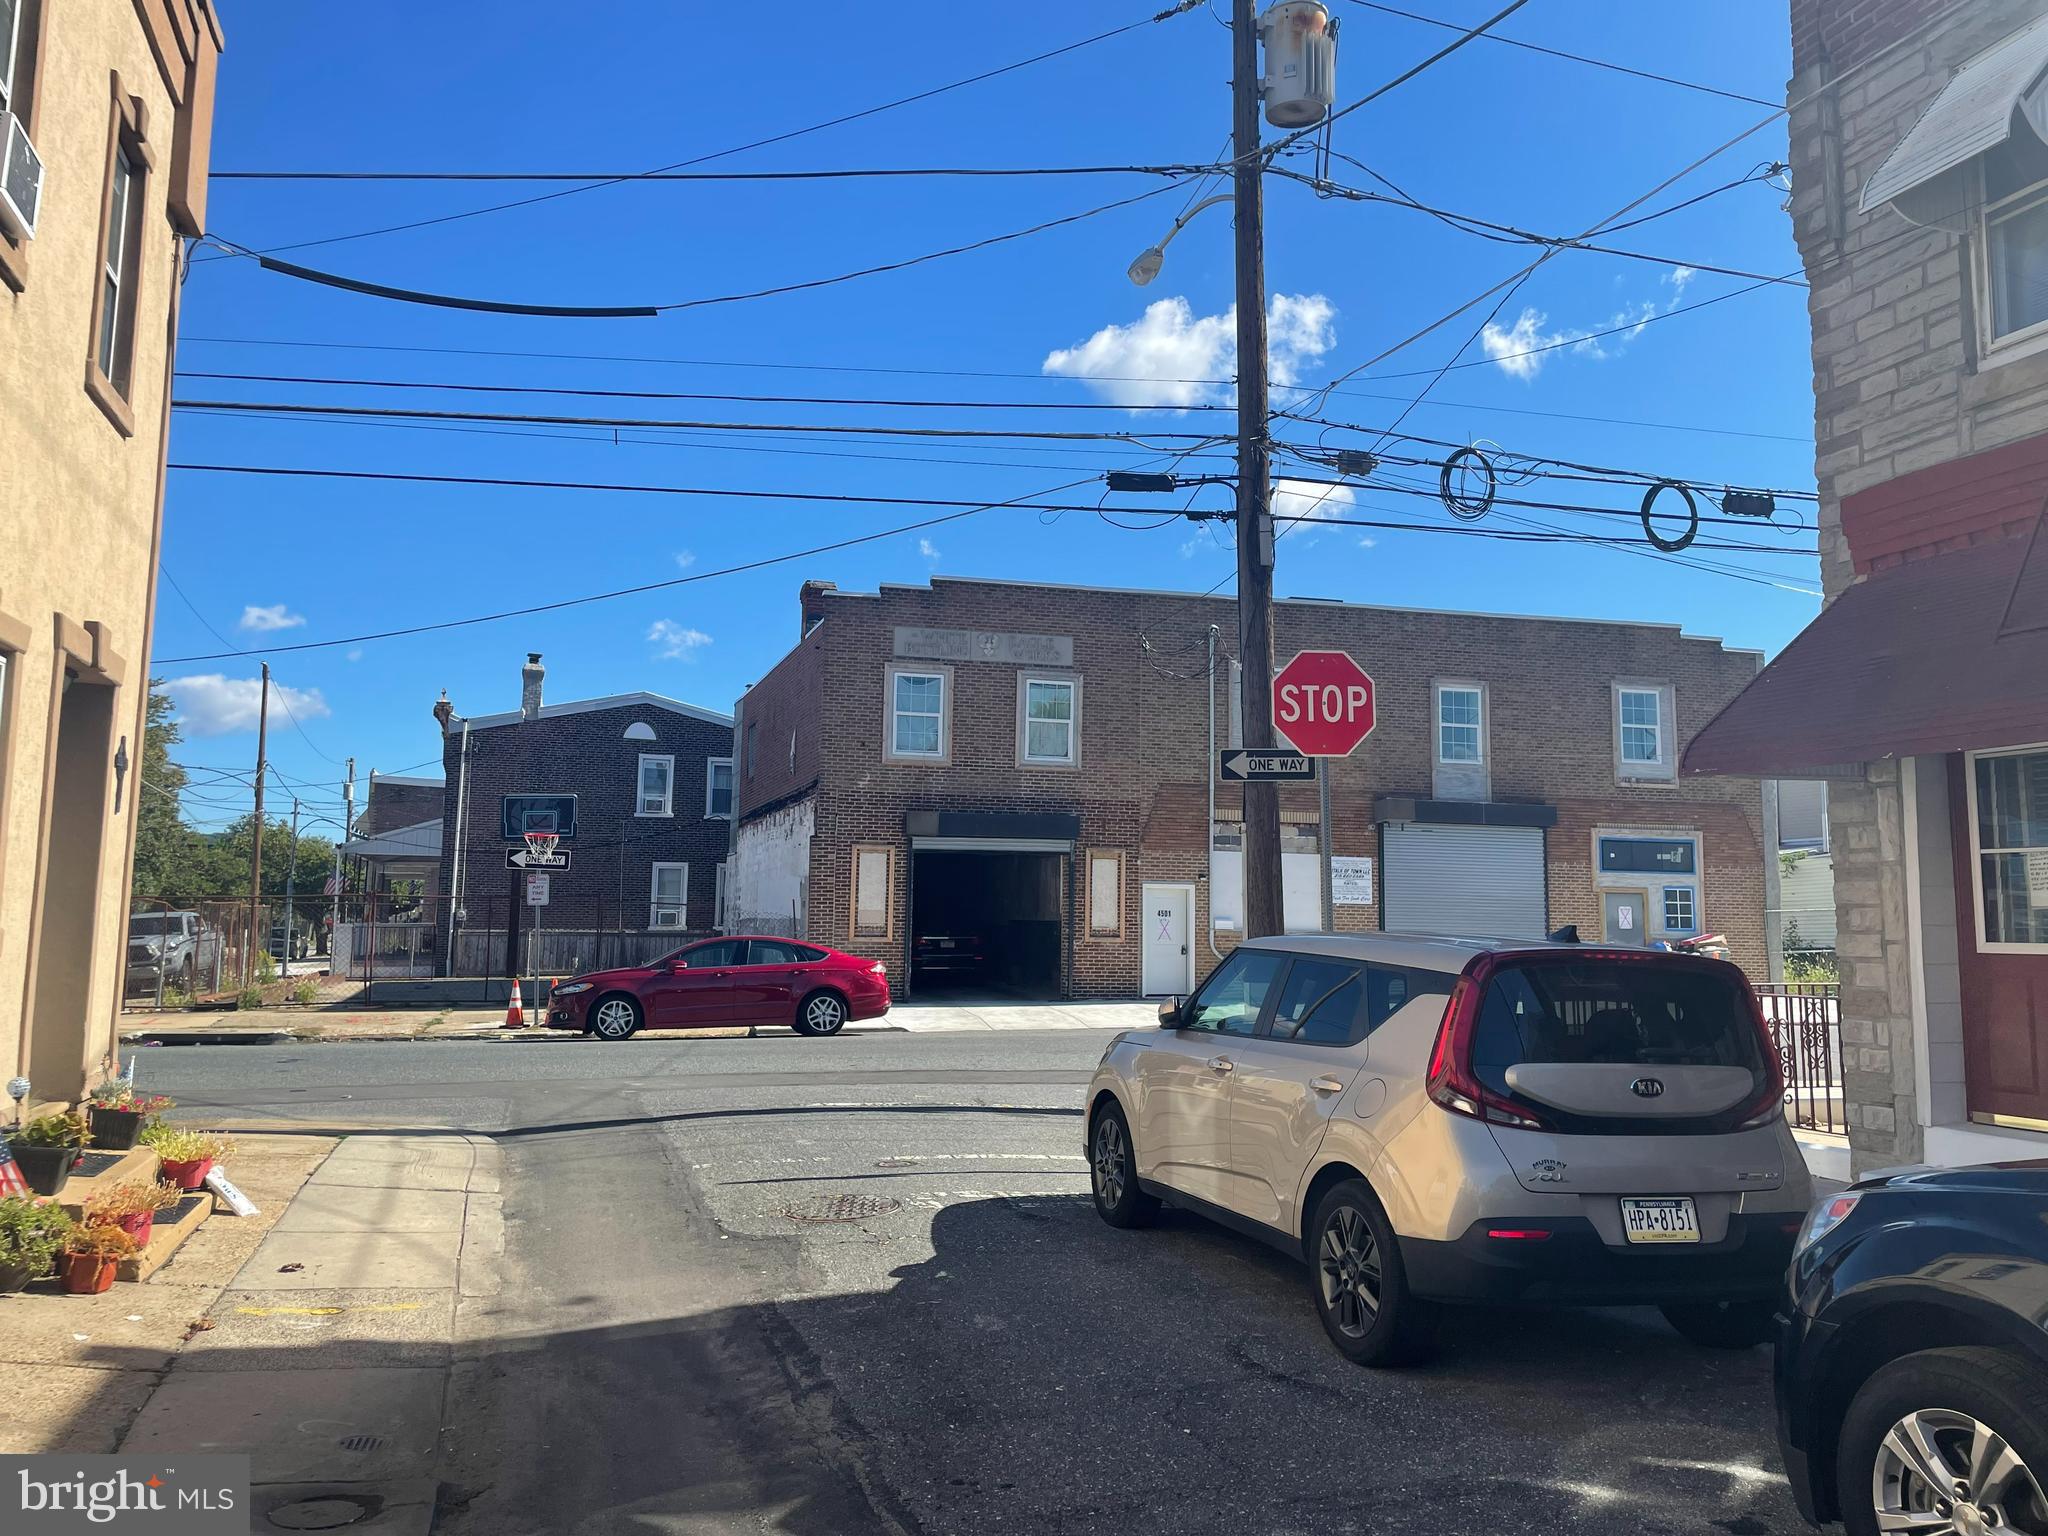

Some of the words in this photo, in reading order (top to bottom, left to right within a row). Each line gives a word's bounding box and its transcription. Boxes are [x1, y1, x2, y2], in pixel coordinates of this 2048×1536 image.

[1280, 684, 1367, 723] STOP
[1249, 759, 1274, 771] ONE
[1280, 759, 1305, 771] WAY
[525, 855, 542, 863] ONE
[1637, 1081, 1662, 1094] KIA
[1532, 1158, 1568, 1170] MURRAY
